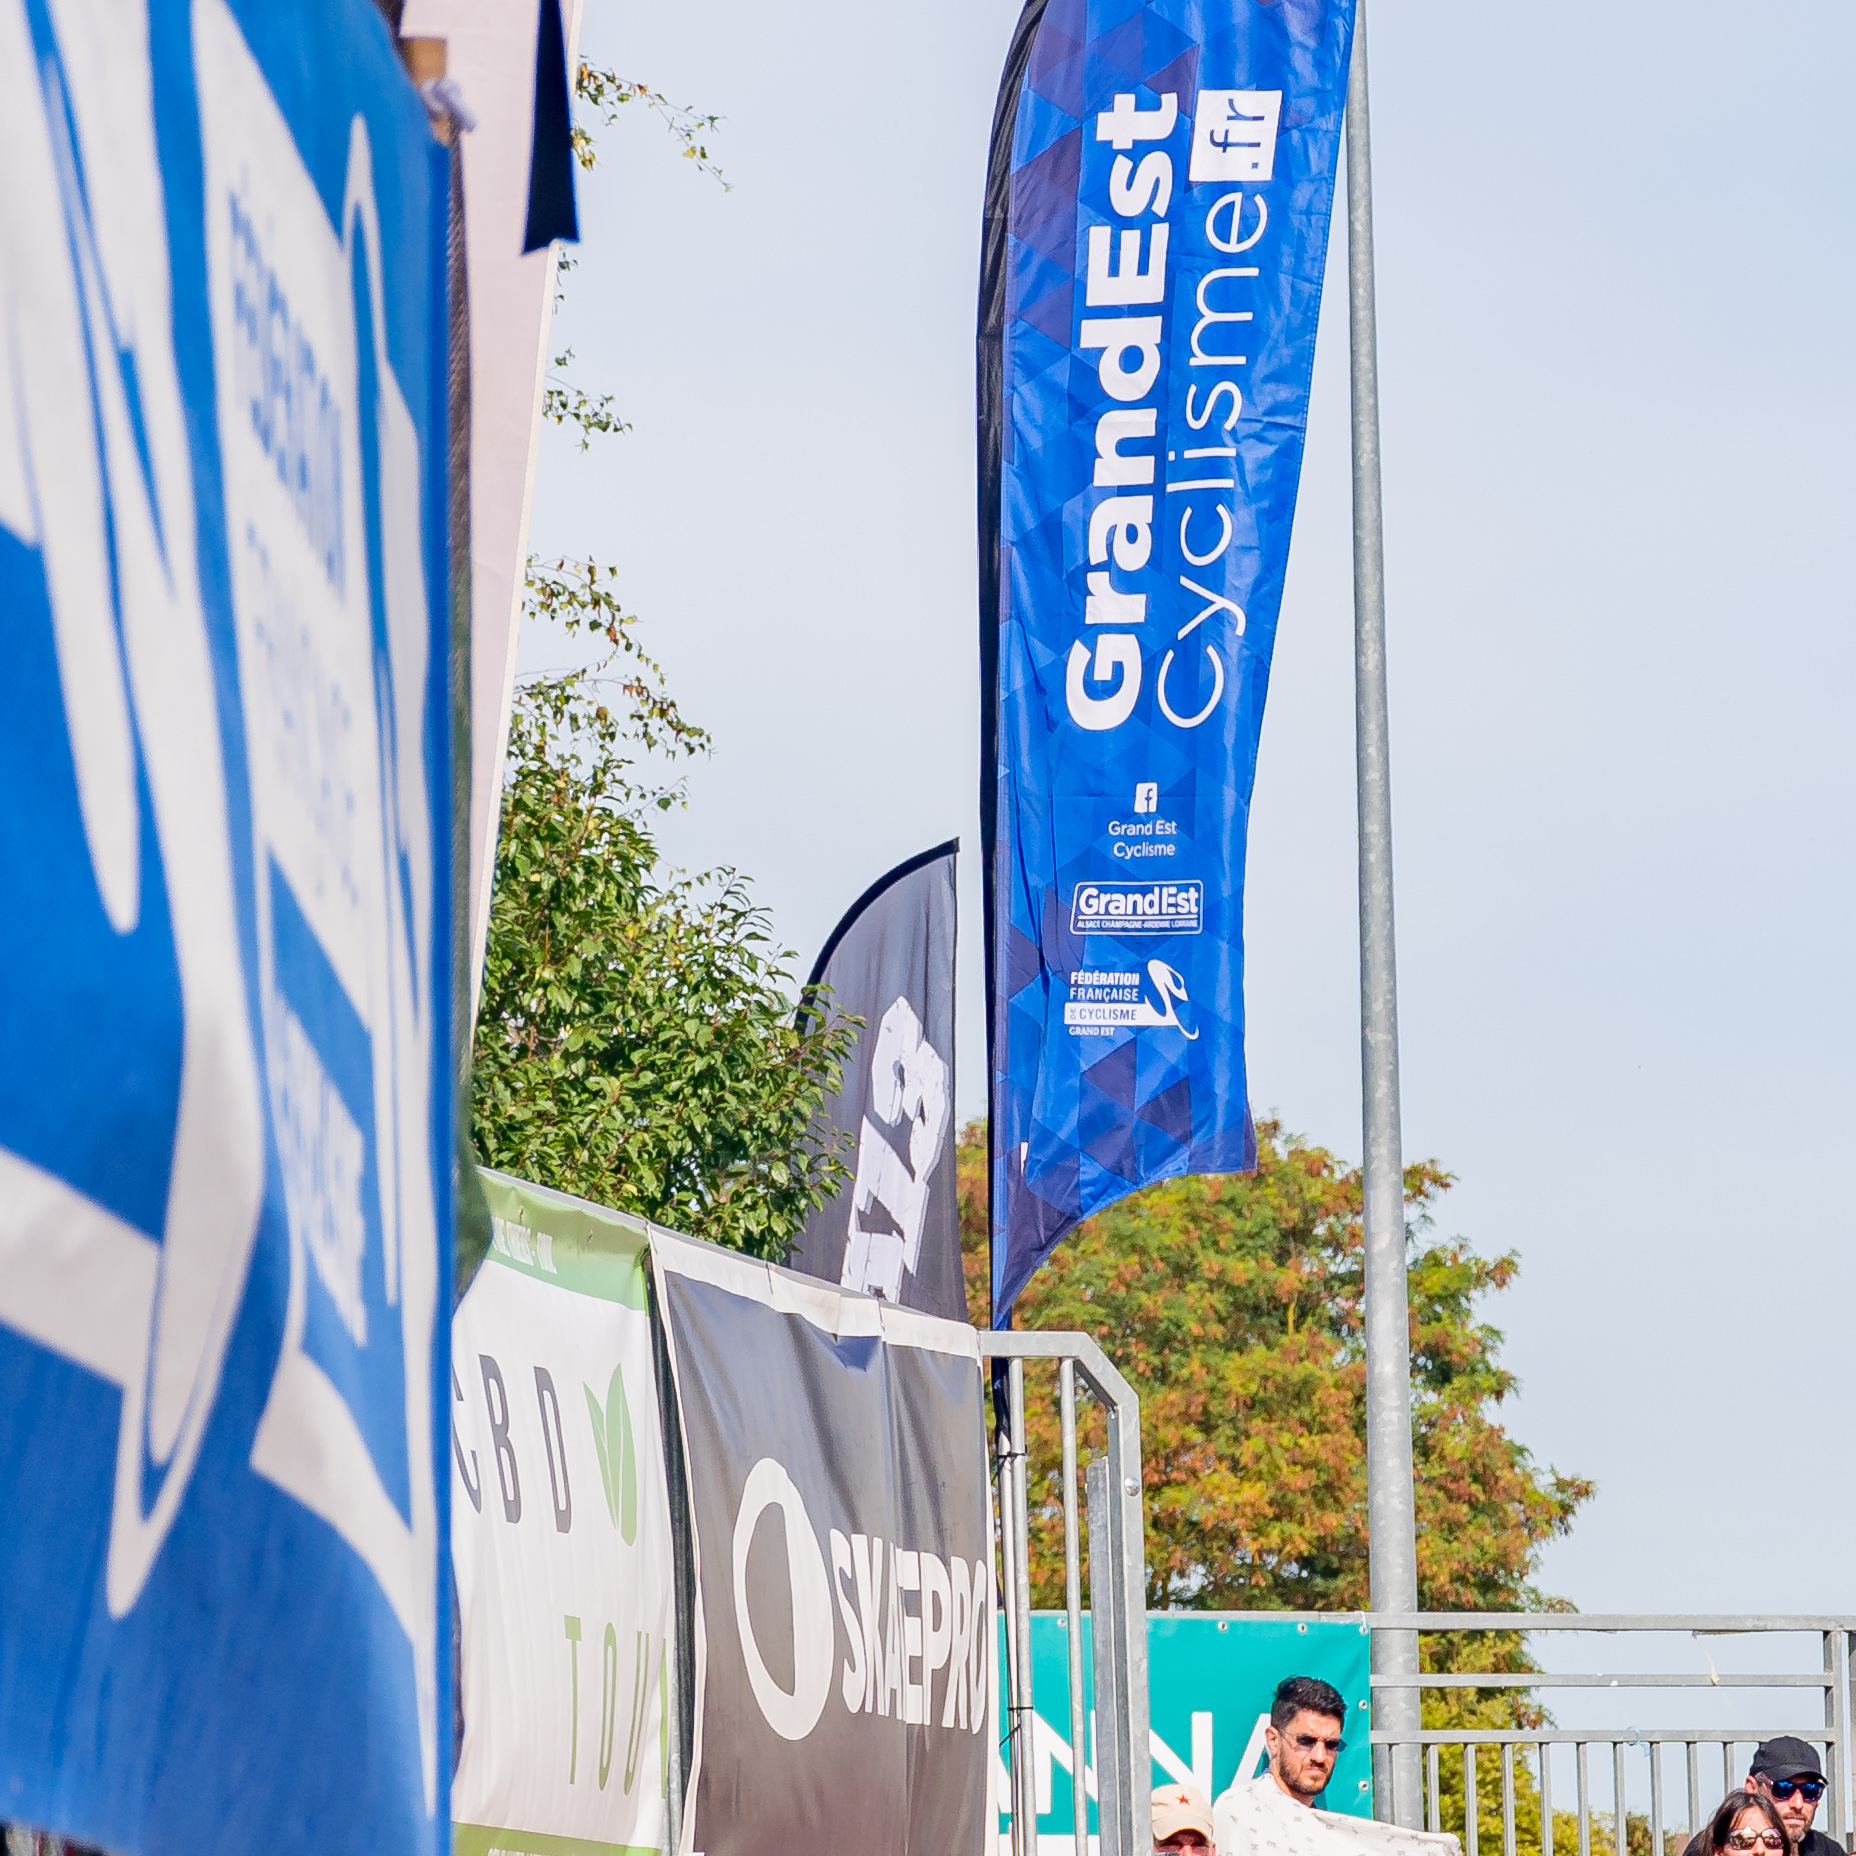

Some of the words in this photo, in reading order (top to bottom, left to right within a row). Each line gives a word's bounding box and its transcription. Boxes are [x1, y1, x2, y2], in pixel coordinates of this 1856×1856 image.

[1066, 92, 1178, 730] GrandEst
[1108, 820, 1152, 836] Grand
[1155, 820, 1177, 835] Est
[1113, 841, 1176, 860] Cyclisme
[1079, 886, 1199, 915] GrandEst
[1070, 969, 1140, 986] FÉDÉRATION
[1069, 987, 1139, 1003] FRANÇAISE
[1079, 1008, 1137, 1020] CYCLISME
[1069, 1026, 1099, 1036] GRAND
[1100, 1026, 1115, 1036] EST
[564, 1615, 668, 1800] TOU
